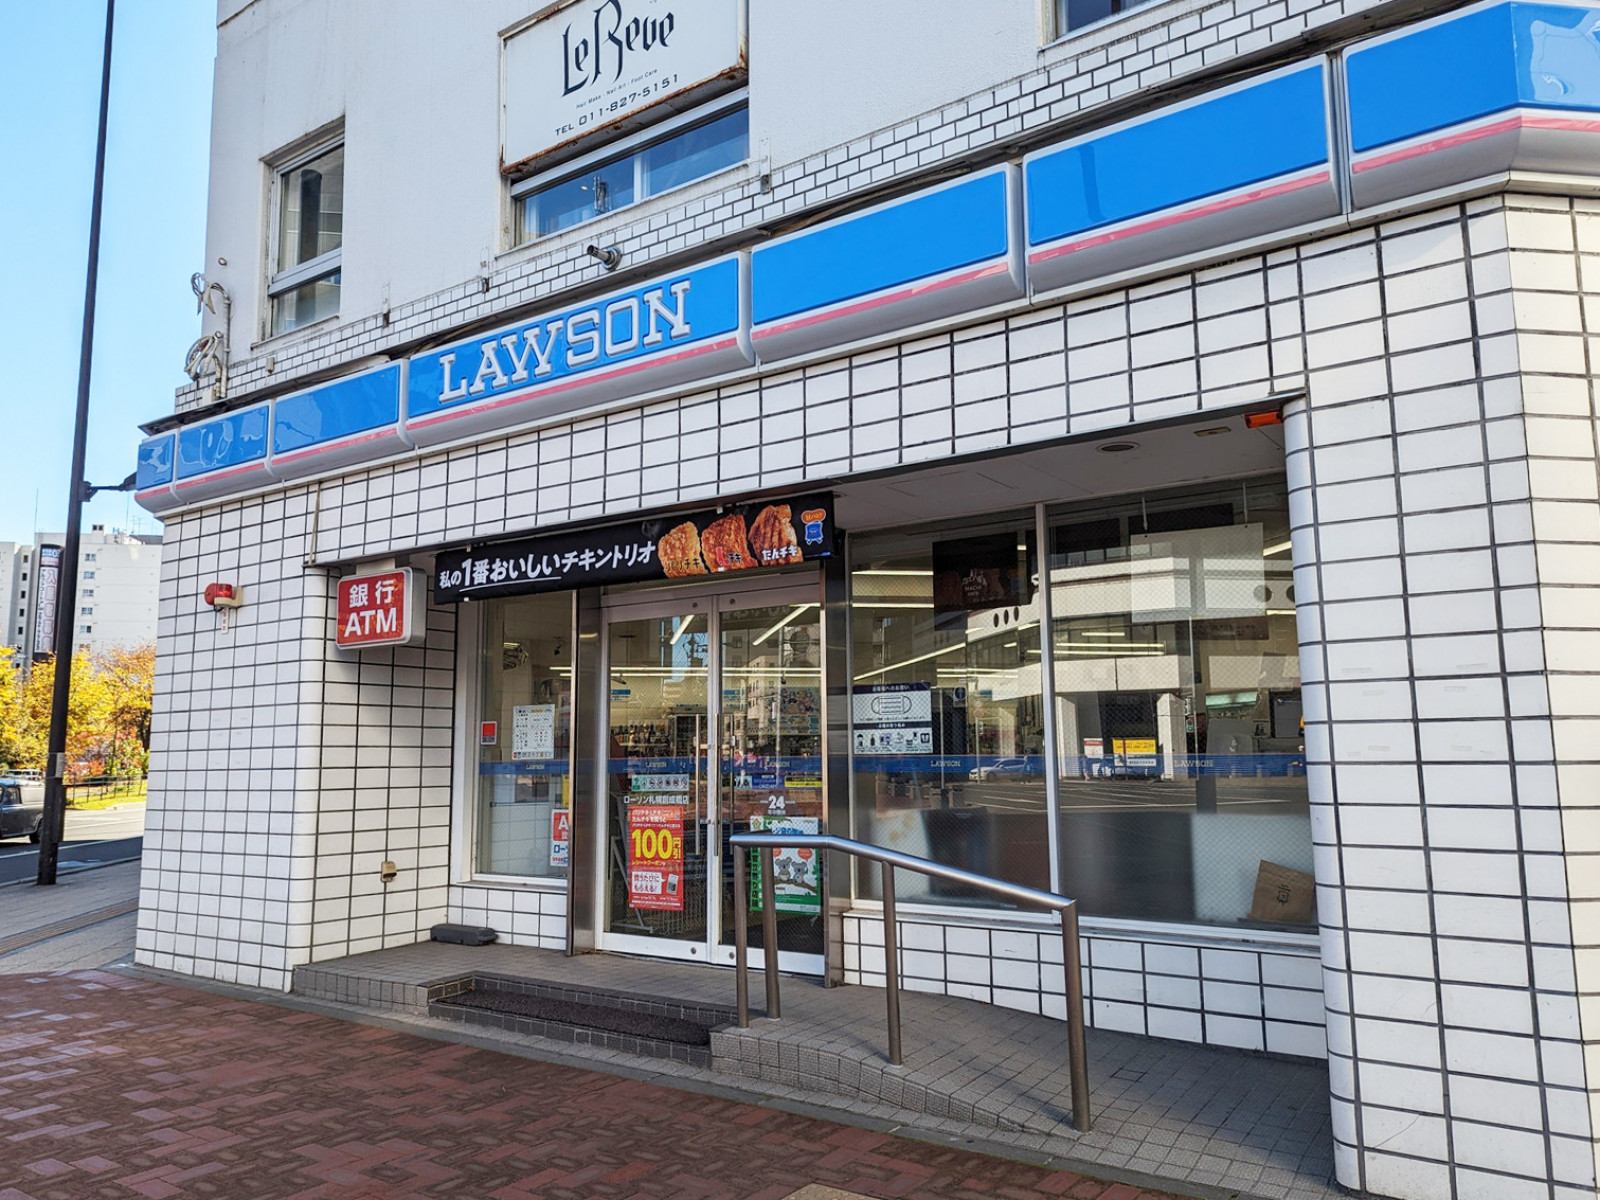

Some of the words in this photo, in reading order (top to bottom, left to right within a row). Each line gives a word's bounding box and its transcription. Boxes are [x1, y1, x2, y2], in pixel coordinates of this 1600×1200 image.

[644, 68, 658, 79] Care
[555, 123, 575, 136] TEL
[578, 73, 678, 126] 011-827-5151
[439, 278, 691, 403] LAWSON
[349, 579, 395, 608] 銀行
[344, 607, 397, 637] ATM
[769, 795, 785, 809] 24
